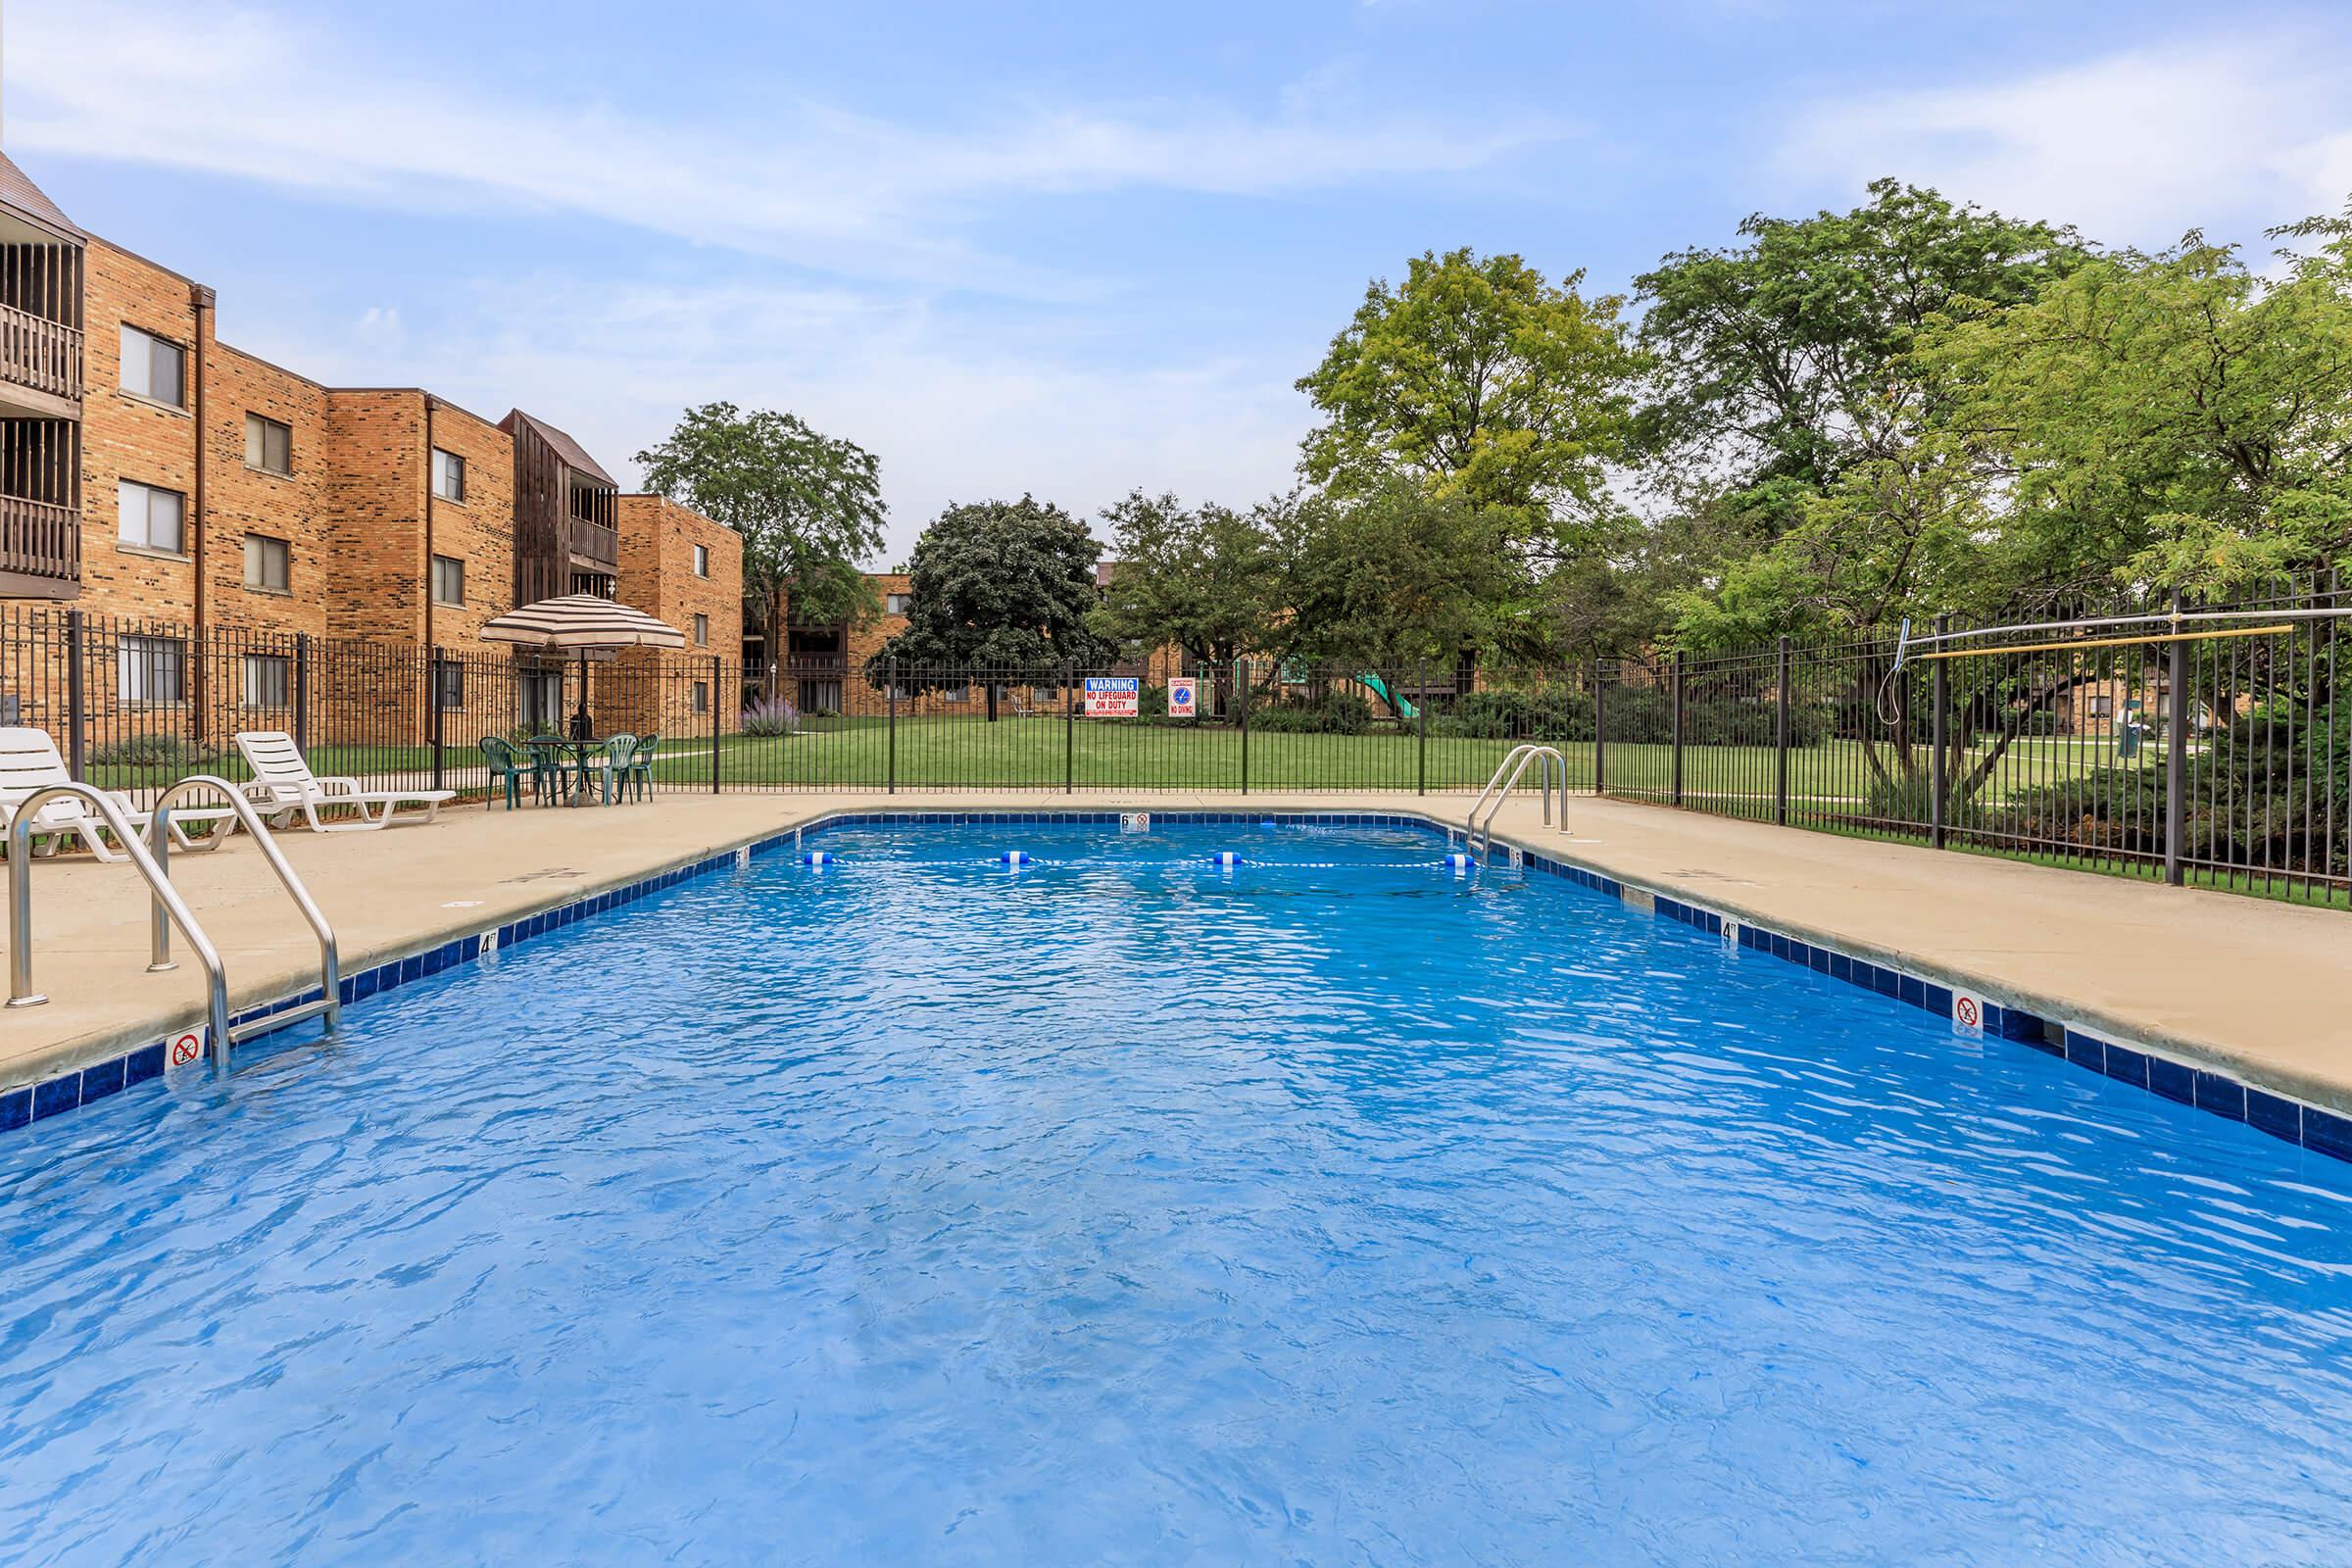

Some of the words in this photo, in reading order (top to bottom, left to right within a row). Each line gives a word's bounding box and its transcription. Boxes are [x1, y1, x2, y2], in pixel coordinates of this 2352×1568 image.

[1089, 679, 1135, 691] WARNING
[1086, 691, 1097, 700] NO
[1099, 691, 1137, 700] LIFEGUARD
[1096, 700, 1105, 710] ON
[1108, 700, 1127, 710] DUTY
[1170, 705, 1177, 714] NO
[1178, 705, 1193, 714] DIVING
[1121, 814, 1129, 826] 6
[1723, 921, 1731, 939] 4
[481, 934, 490, 954] 4
